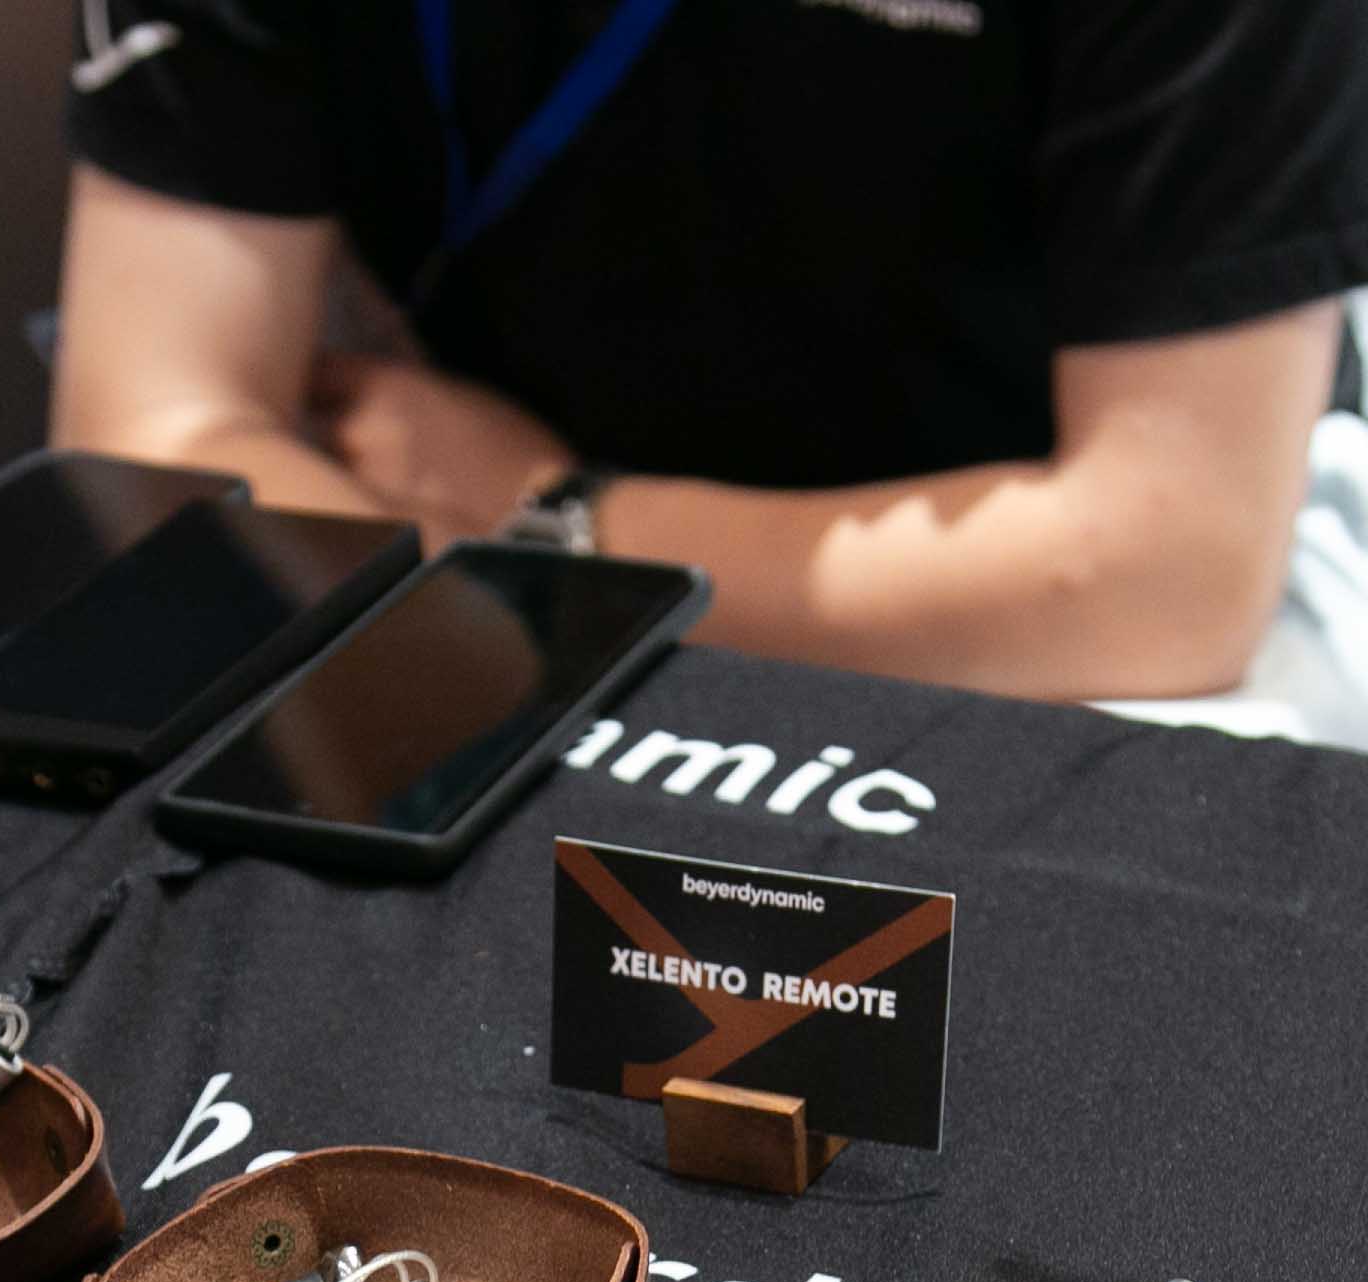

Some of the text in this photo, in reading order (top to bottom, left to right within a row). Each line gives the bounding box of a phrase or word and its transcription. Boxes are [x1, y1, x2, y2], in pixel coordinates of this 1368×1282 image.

[682, 872, 826, 914] beyerdynamic
[610, 946, 898, 1019] XELENTO REMOTE
